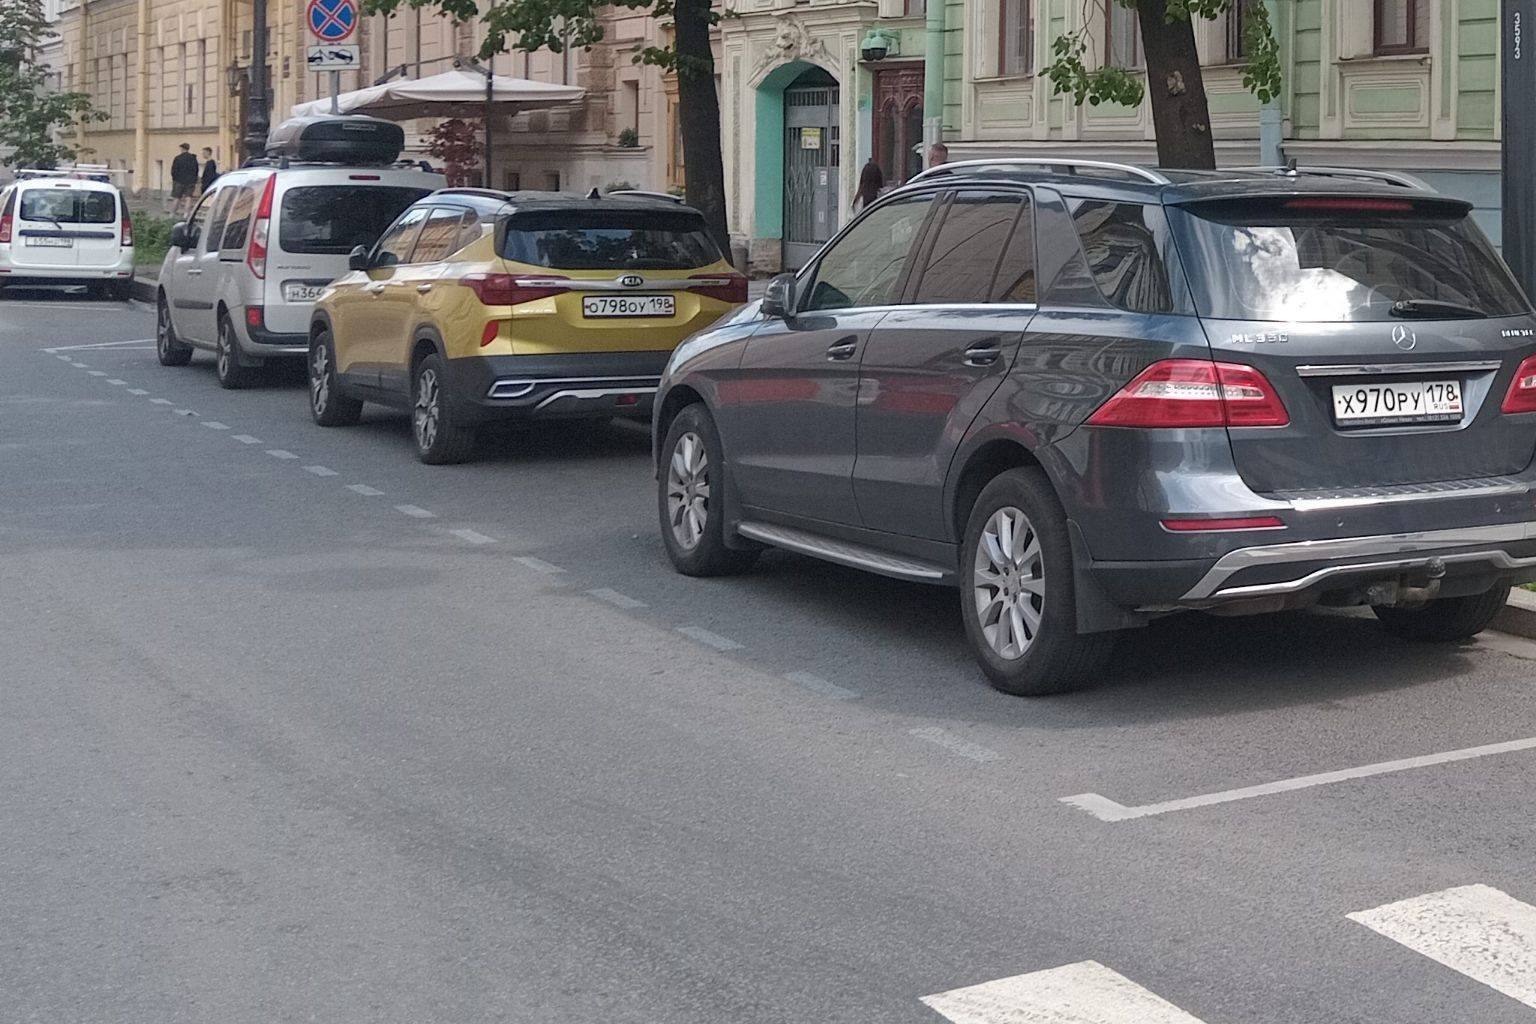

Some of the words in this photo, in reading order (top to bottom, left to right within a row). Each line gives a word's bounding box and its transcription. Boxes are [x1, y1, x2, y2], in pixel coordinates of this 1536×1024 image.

[624, 276, 642, 285] KIA
[649, 298, 670, 309] 198
[1342, 387, 1421, 414] Х970РУ
[1426, 384, 1455, 403] 178
